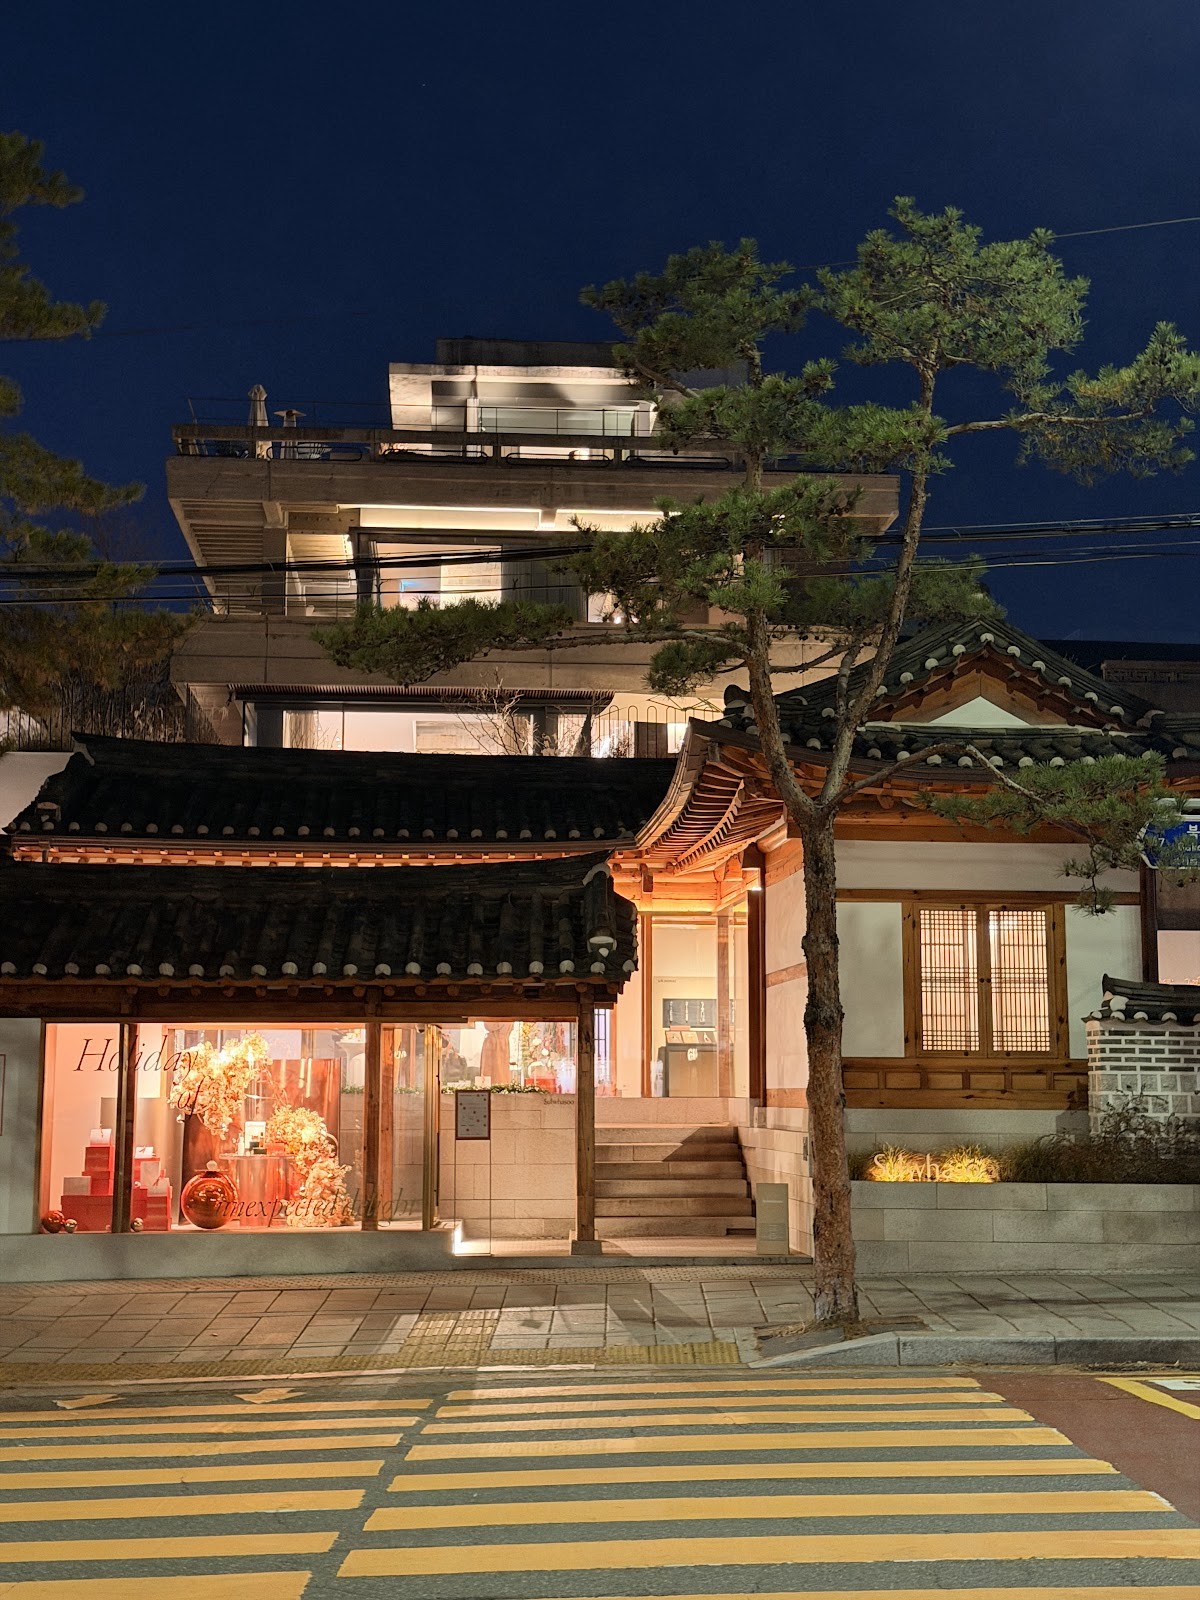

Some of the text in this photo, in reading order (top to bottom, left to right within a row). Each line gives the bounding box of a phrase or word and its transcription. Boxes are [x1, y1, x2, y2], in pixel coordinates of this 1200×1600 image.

[73, 1035, 198, 1086] Holiday
[177, 1074, 209, 1120] of
[215, 1187, 341, 1228] unexpected
